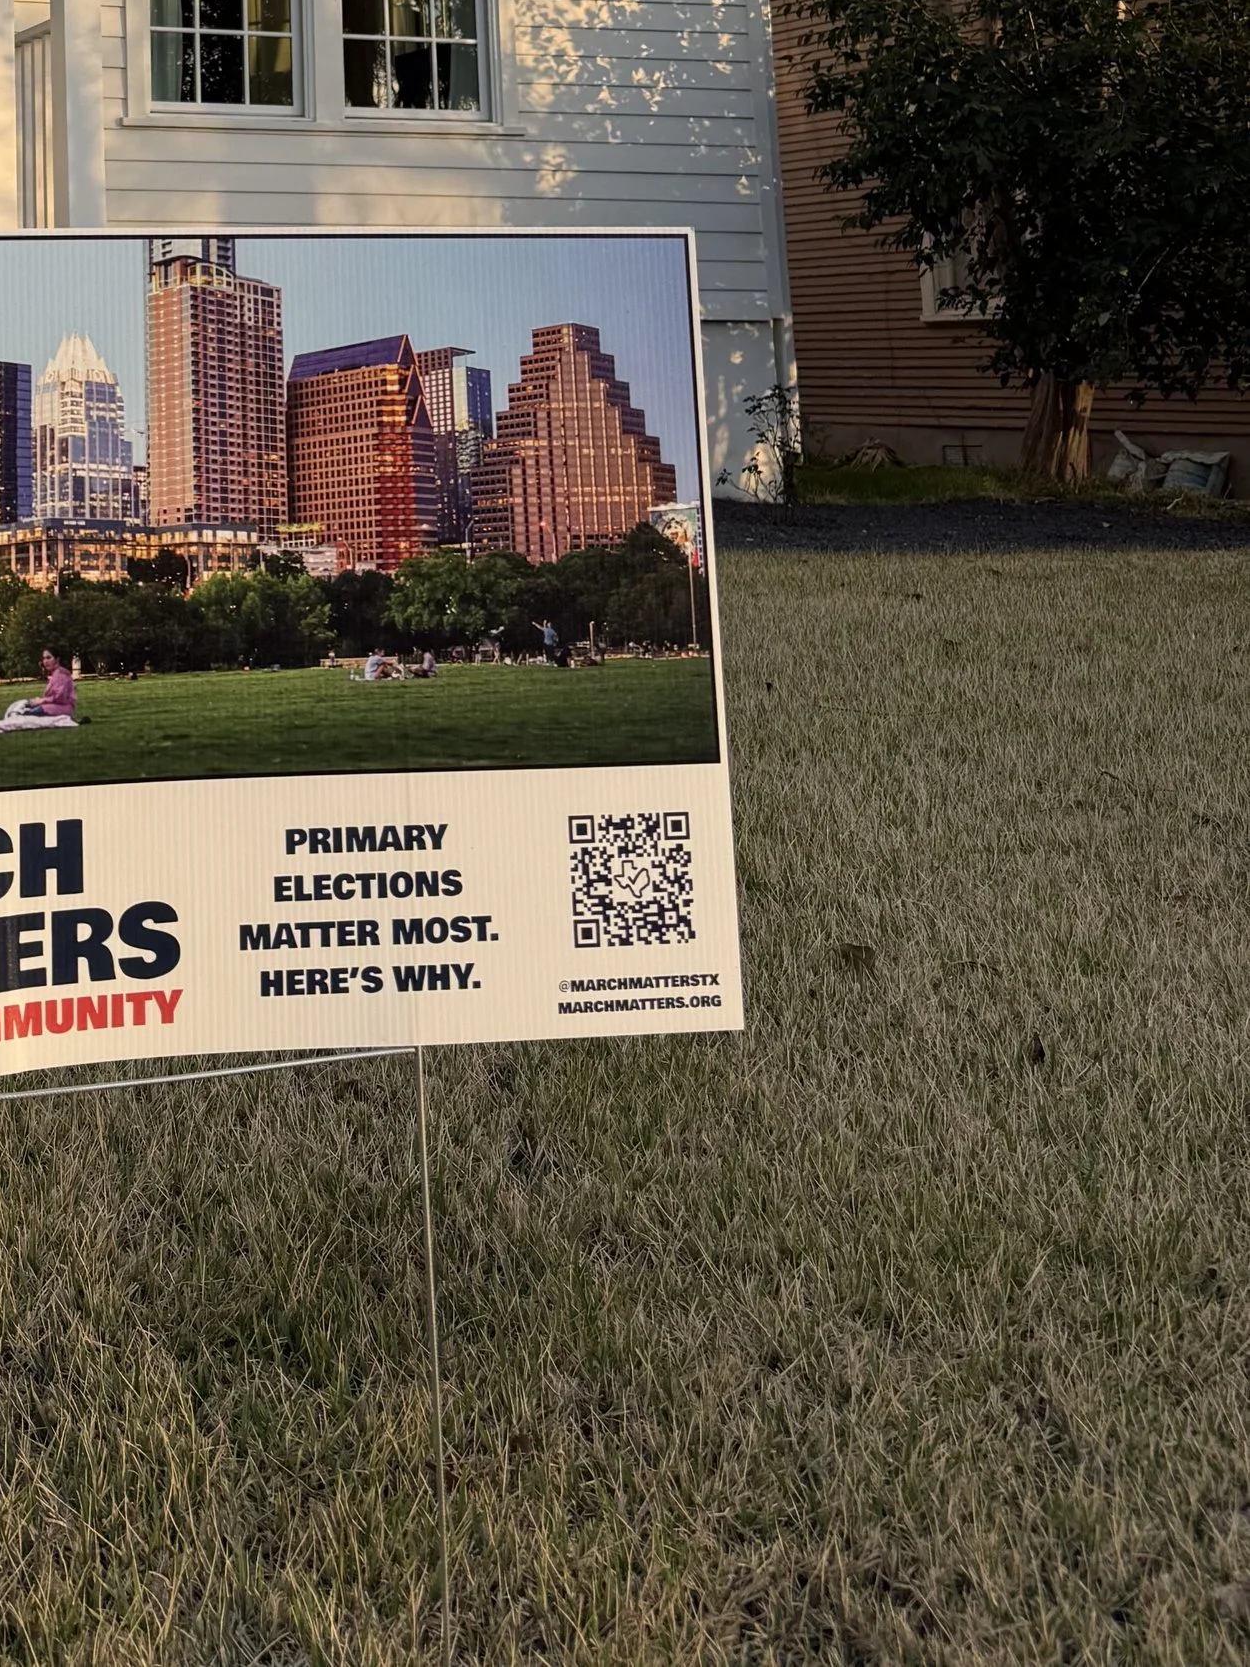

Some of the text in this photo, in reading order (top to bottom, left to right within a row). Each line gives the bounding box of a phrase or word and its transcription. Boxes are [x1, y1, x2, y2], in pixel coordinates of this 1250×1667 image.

[285, 823, 448, 855] PRIMARY
[273, 870, 463, 903] ELECTIONS
[239, 915, 499, 951] MATTER MOST.
[260, 962, 481, 997] HERE'S WHY.
[558, 973, 720, 993] @MARCHMATTERSTX
[557, 995, 722, 1015] MARCHMATTERS.ORG
